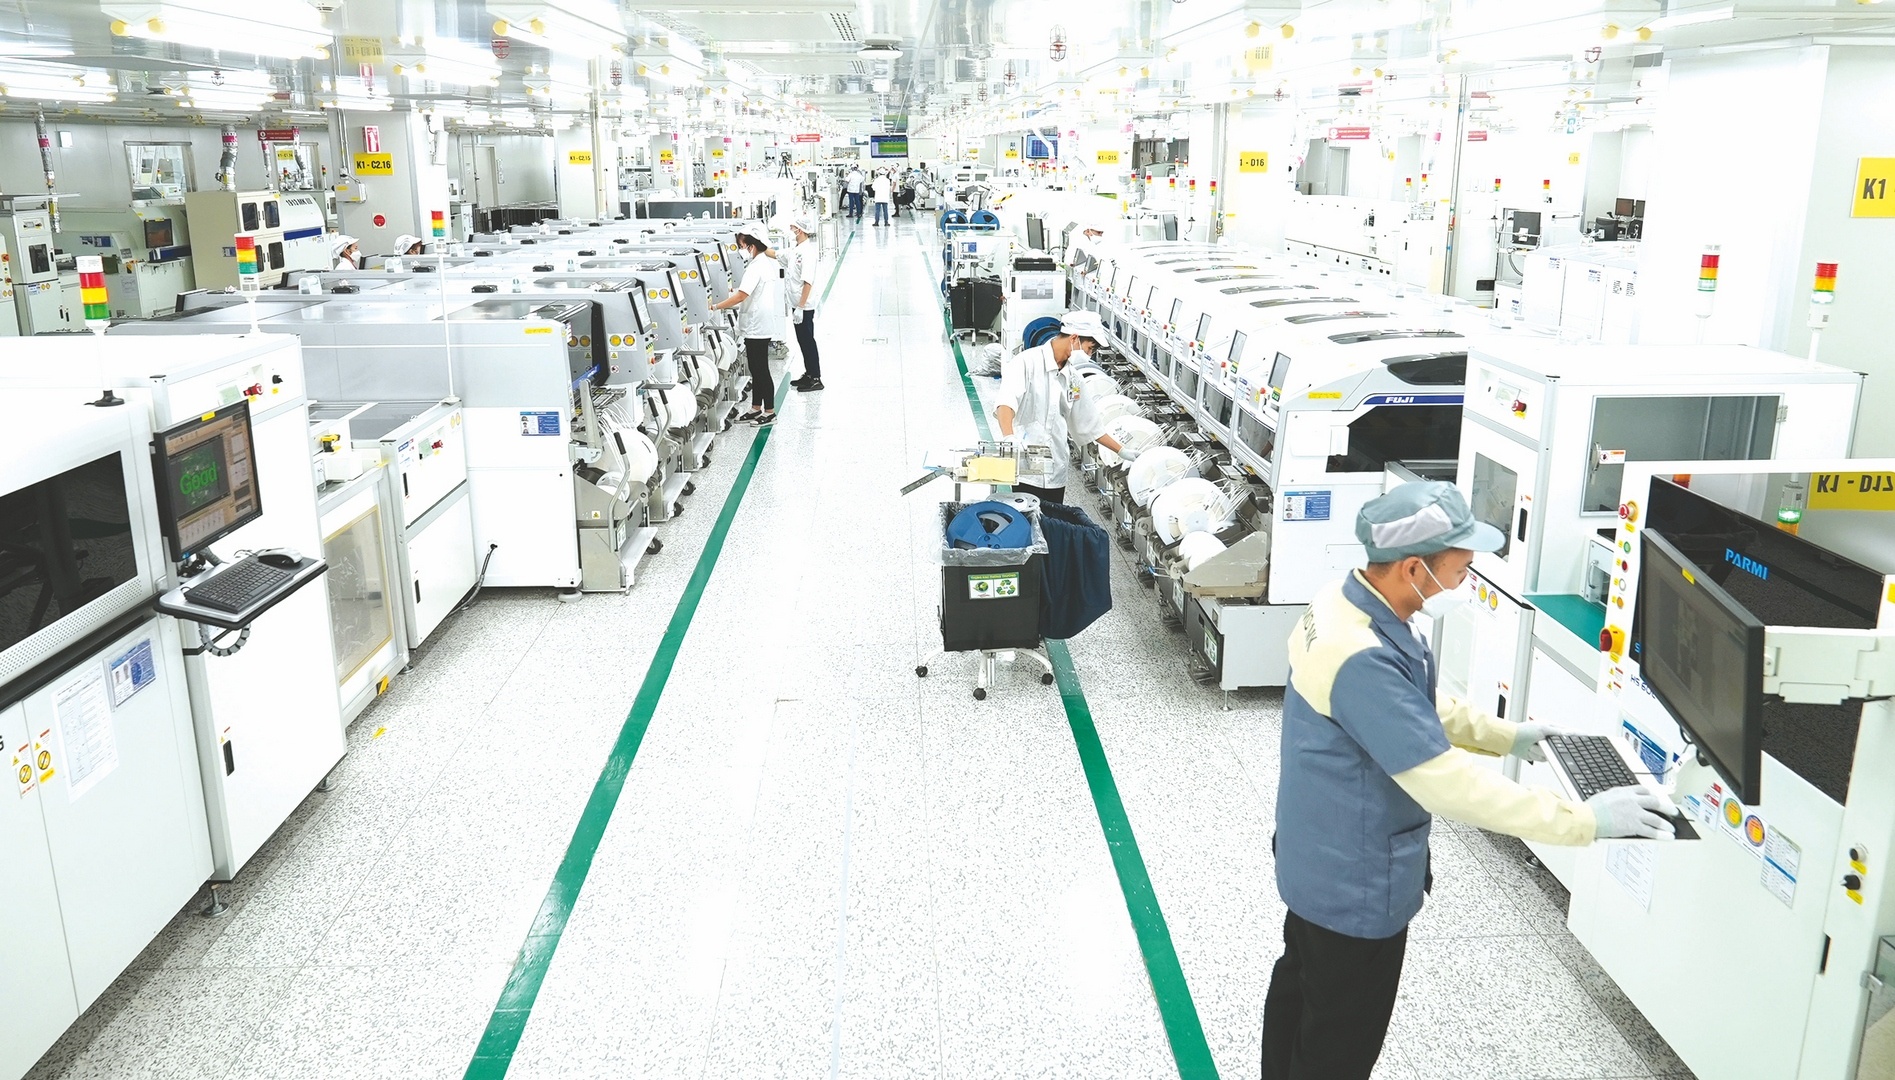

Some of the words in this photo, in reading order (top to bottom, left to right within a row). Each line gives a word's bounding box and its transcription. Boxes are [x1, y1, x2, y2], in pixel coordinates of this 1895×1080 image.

[356, 161, 365, 169] K1
[371, 160, 391, 169] C2.16
[1862, 178, 1886, 200] K1
[1385, 396, 1414, 404] FUJI
[179, 461, 218, 495] Good
[1724, 548, 1769, 581] PARMI
